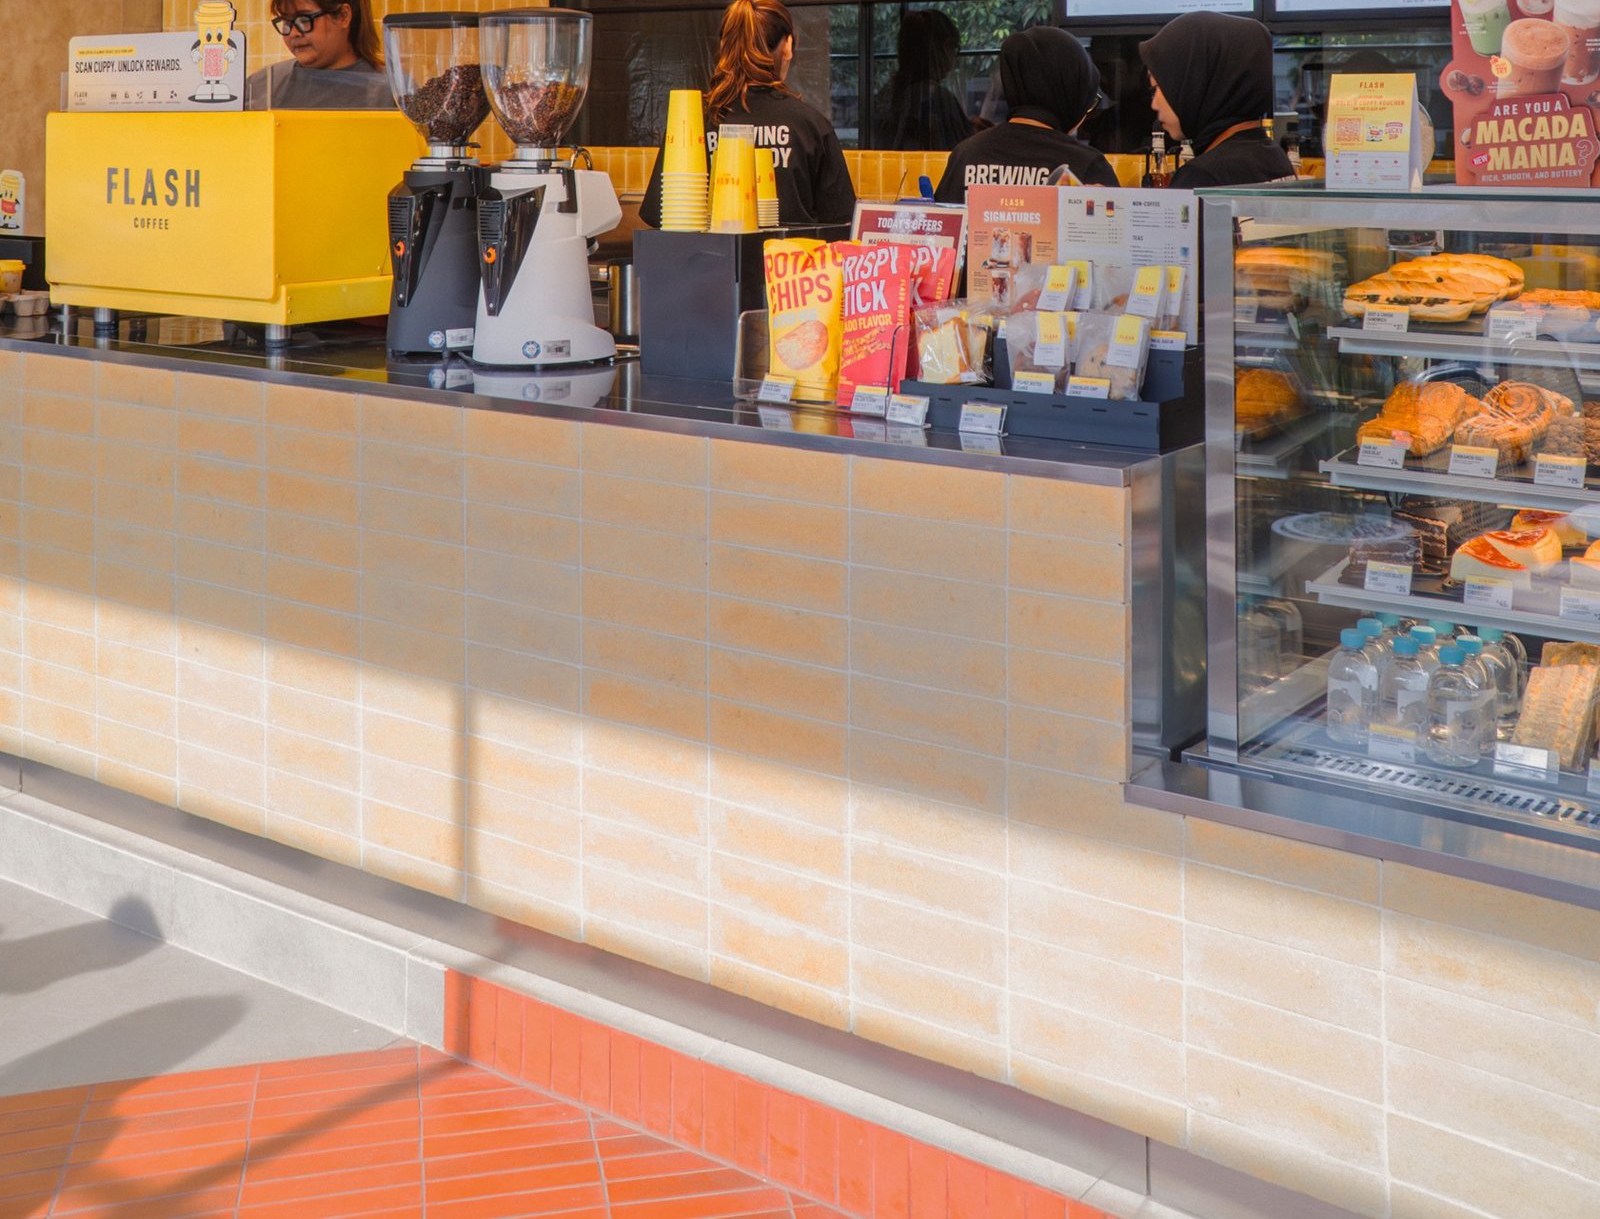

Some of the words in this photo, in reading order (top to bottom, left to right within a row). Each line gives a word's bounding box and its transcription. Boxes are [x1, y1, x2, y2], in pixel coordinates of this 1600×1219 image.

[75, 61, 92, 74] SCAN
[94, 60, 117, 73] CUPPY.
[118, 59, 144, 72] UNLOCK
[146, 58, 182, 71] REWARDS.
[1494, 104, 1518, 116] ARE
[1525, 102, 1550, 113] YOU
[1554, 100, 1562, 111] A
[1476, 113, 1588, 145] MACADA
[707, 125, 790, 152] BING
[1473, 154, 1489, 165] NEW
[965, 164, 1049, 186] BREWING
[1535, 171, 1549, 179] AND
[1551, 169, 1582, 178] BUTTERY
[107, 167, 200, 207] FLASH
[1000, 198, 1025, 207] FLASH
[134, 217, 169, 230] COFFEE
[878, 217, 910, 230] TODAY'S
[911, 219, 943, 232] OFFERS
[984, 210, 1041, 225] SIGNATURES
[844, 246, 898, 284] RISPY
[770, 273, 833, 315] CHIPS
[844, 279, 889, 317] TICK
[859, 313, 893, 330] FLAVOR
